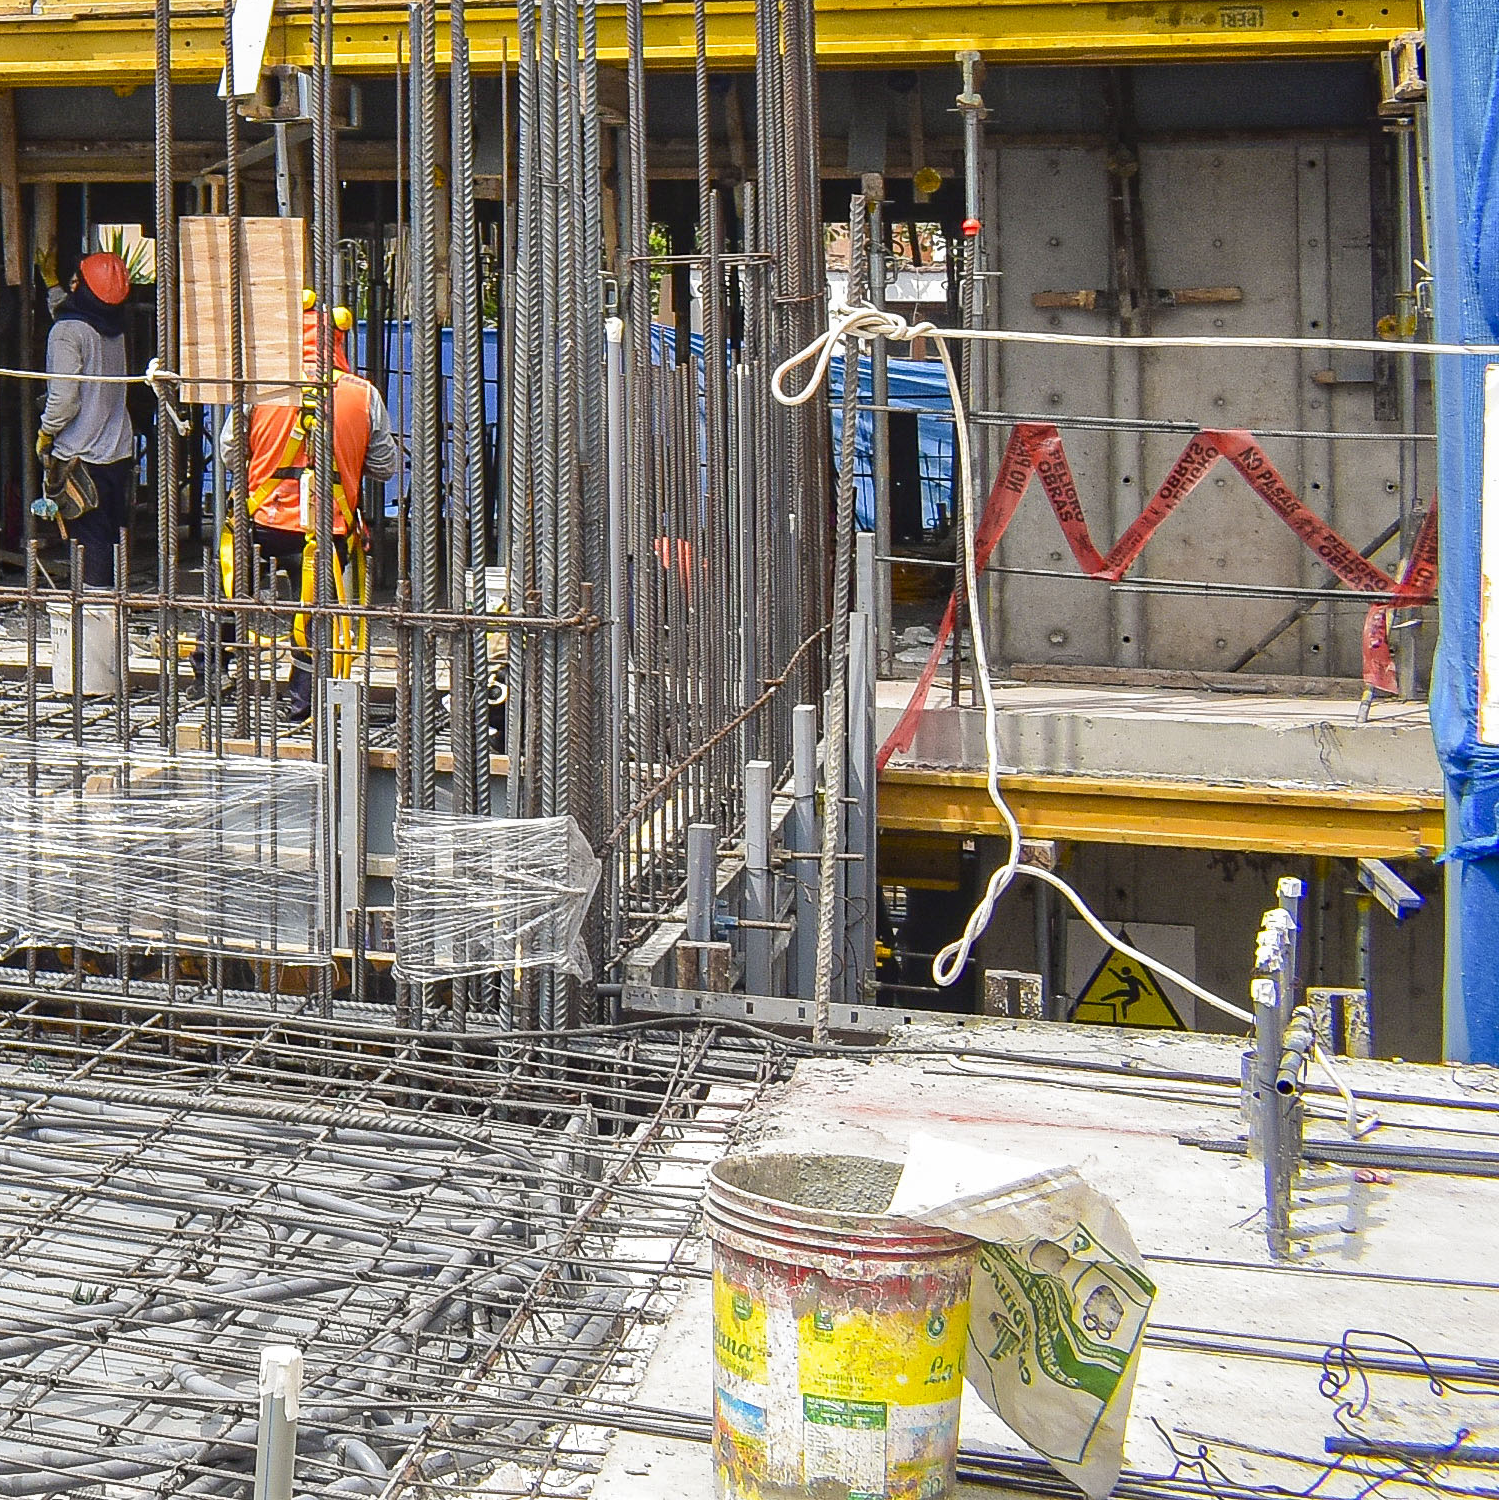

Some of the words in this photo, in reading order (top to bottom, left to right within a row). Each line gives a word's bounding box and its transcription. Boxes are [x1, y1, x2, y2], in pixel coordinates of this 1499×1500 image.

[1037, 460, 1073, 522] OBRAS
[1048, 449, 1085, 523] PELIGRO
[1237, 446, 1263, 471] NO
[1256, 469, 1301, 514] PASAR
[1323, 533, 1389, 591] PELIGRO
